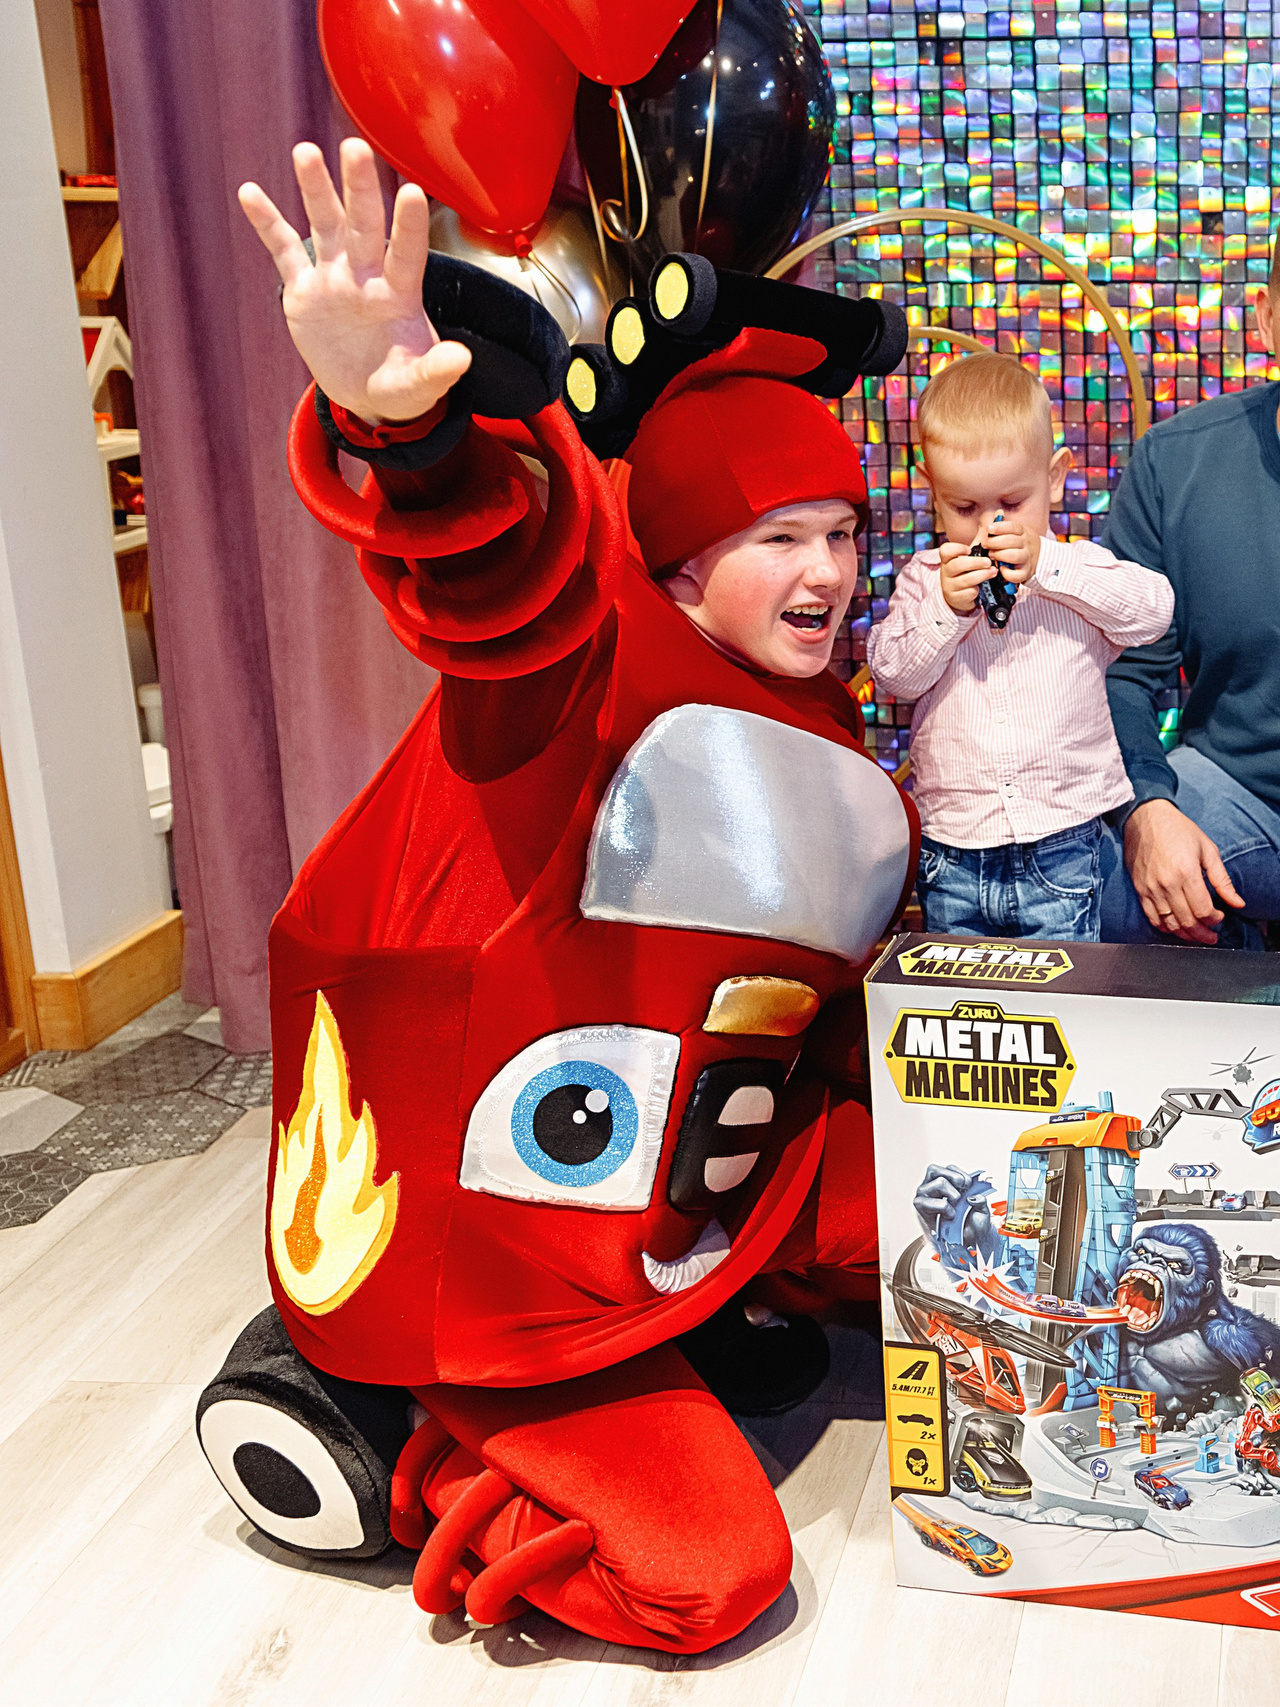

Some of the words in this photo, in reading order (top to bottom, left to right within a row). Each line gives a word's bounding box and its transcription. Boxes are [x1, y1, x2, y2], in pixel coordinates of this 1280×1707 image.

[919, 946, 1056, 966] METAL
[909, 960, 1053, 981] MACHINES
[958, 1006, 998, 1020] ZURU
[904, 1017, 1057, 1065] METAL
[904, 1060, 1058, 1107] MACHINES
